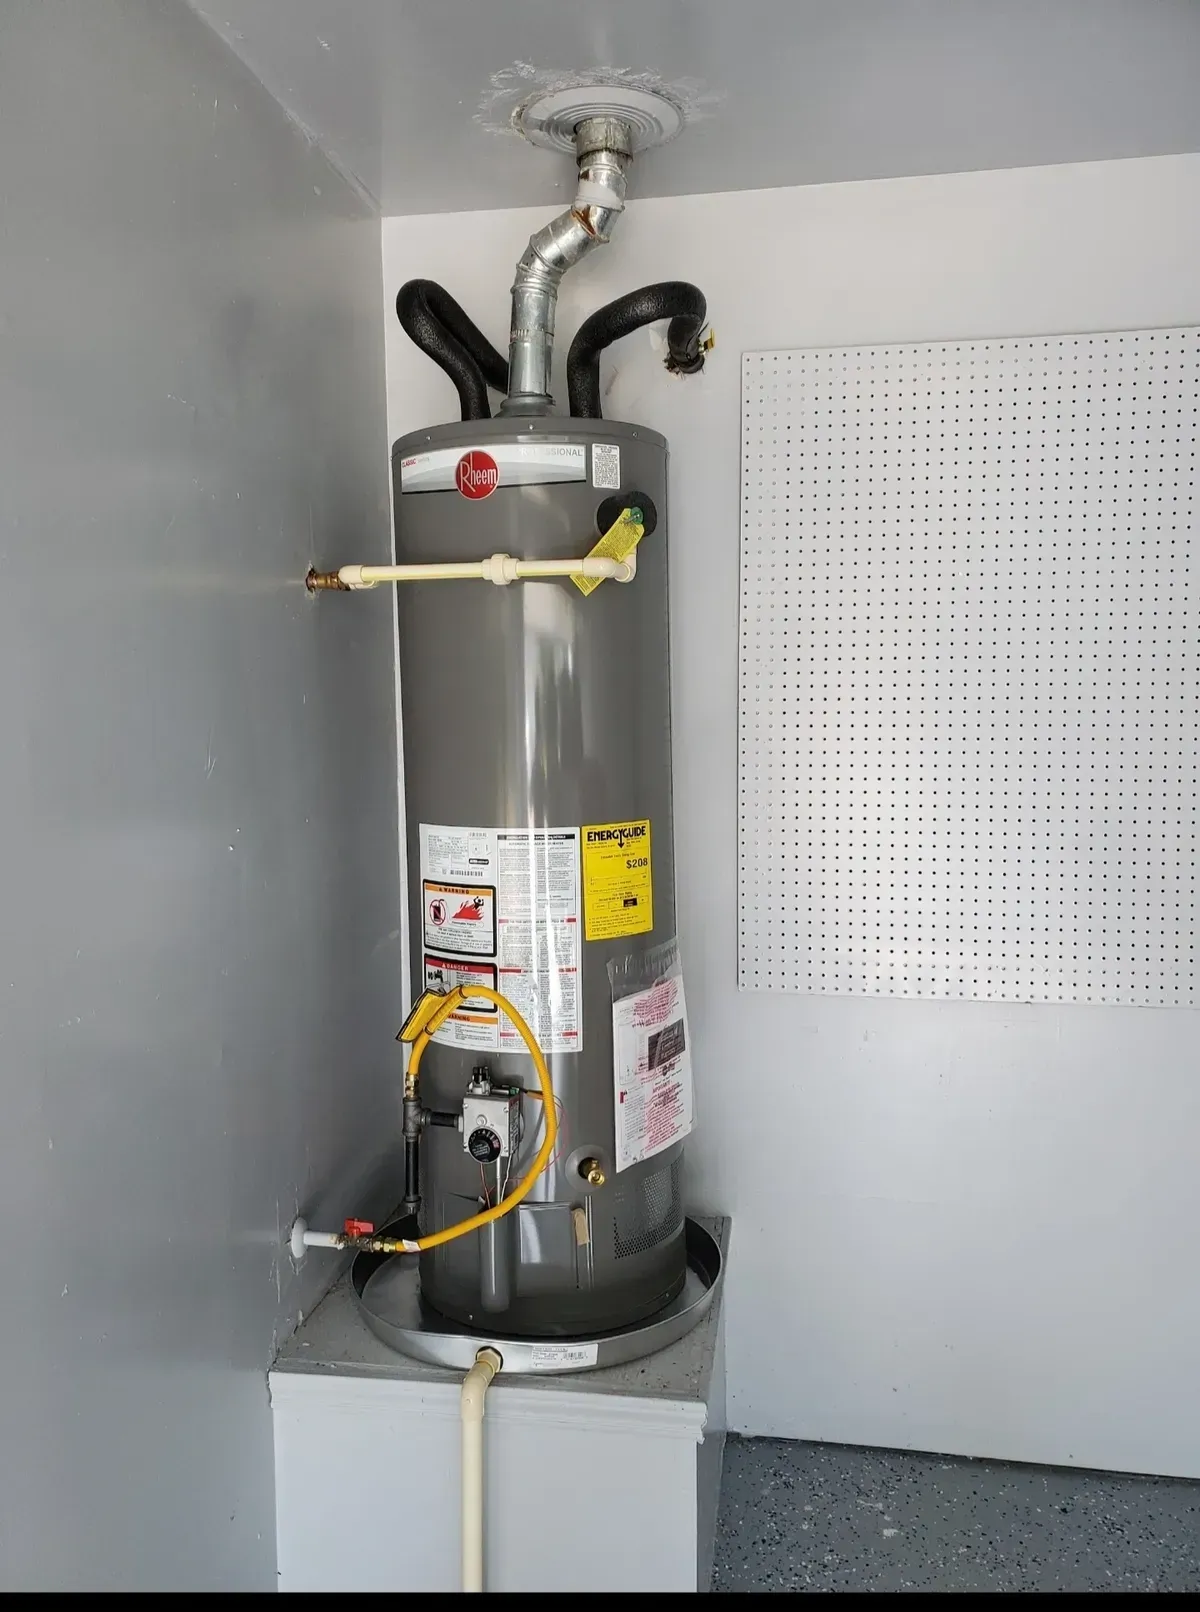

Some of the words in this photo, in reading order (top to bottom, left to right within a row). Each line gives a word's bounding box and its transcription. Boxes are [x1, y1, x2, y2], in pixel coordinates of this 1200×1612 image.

[460, 452, 497, 493] Rheem
[626, 857, 648, 870] $208
[444, 887, 470, 895] WARNING
[446, 962, 469, 971] DANGER
